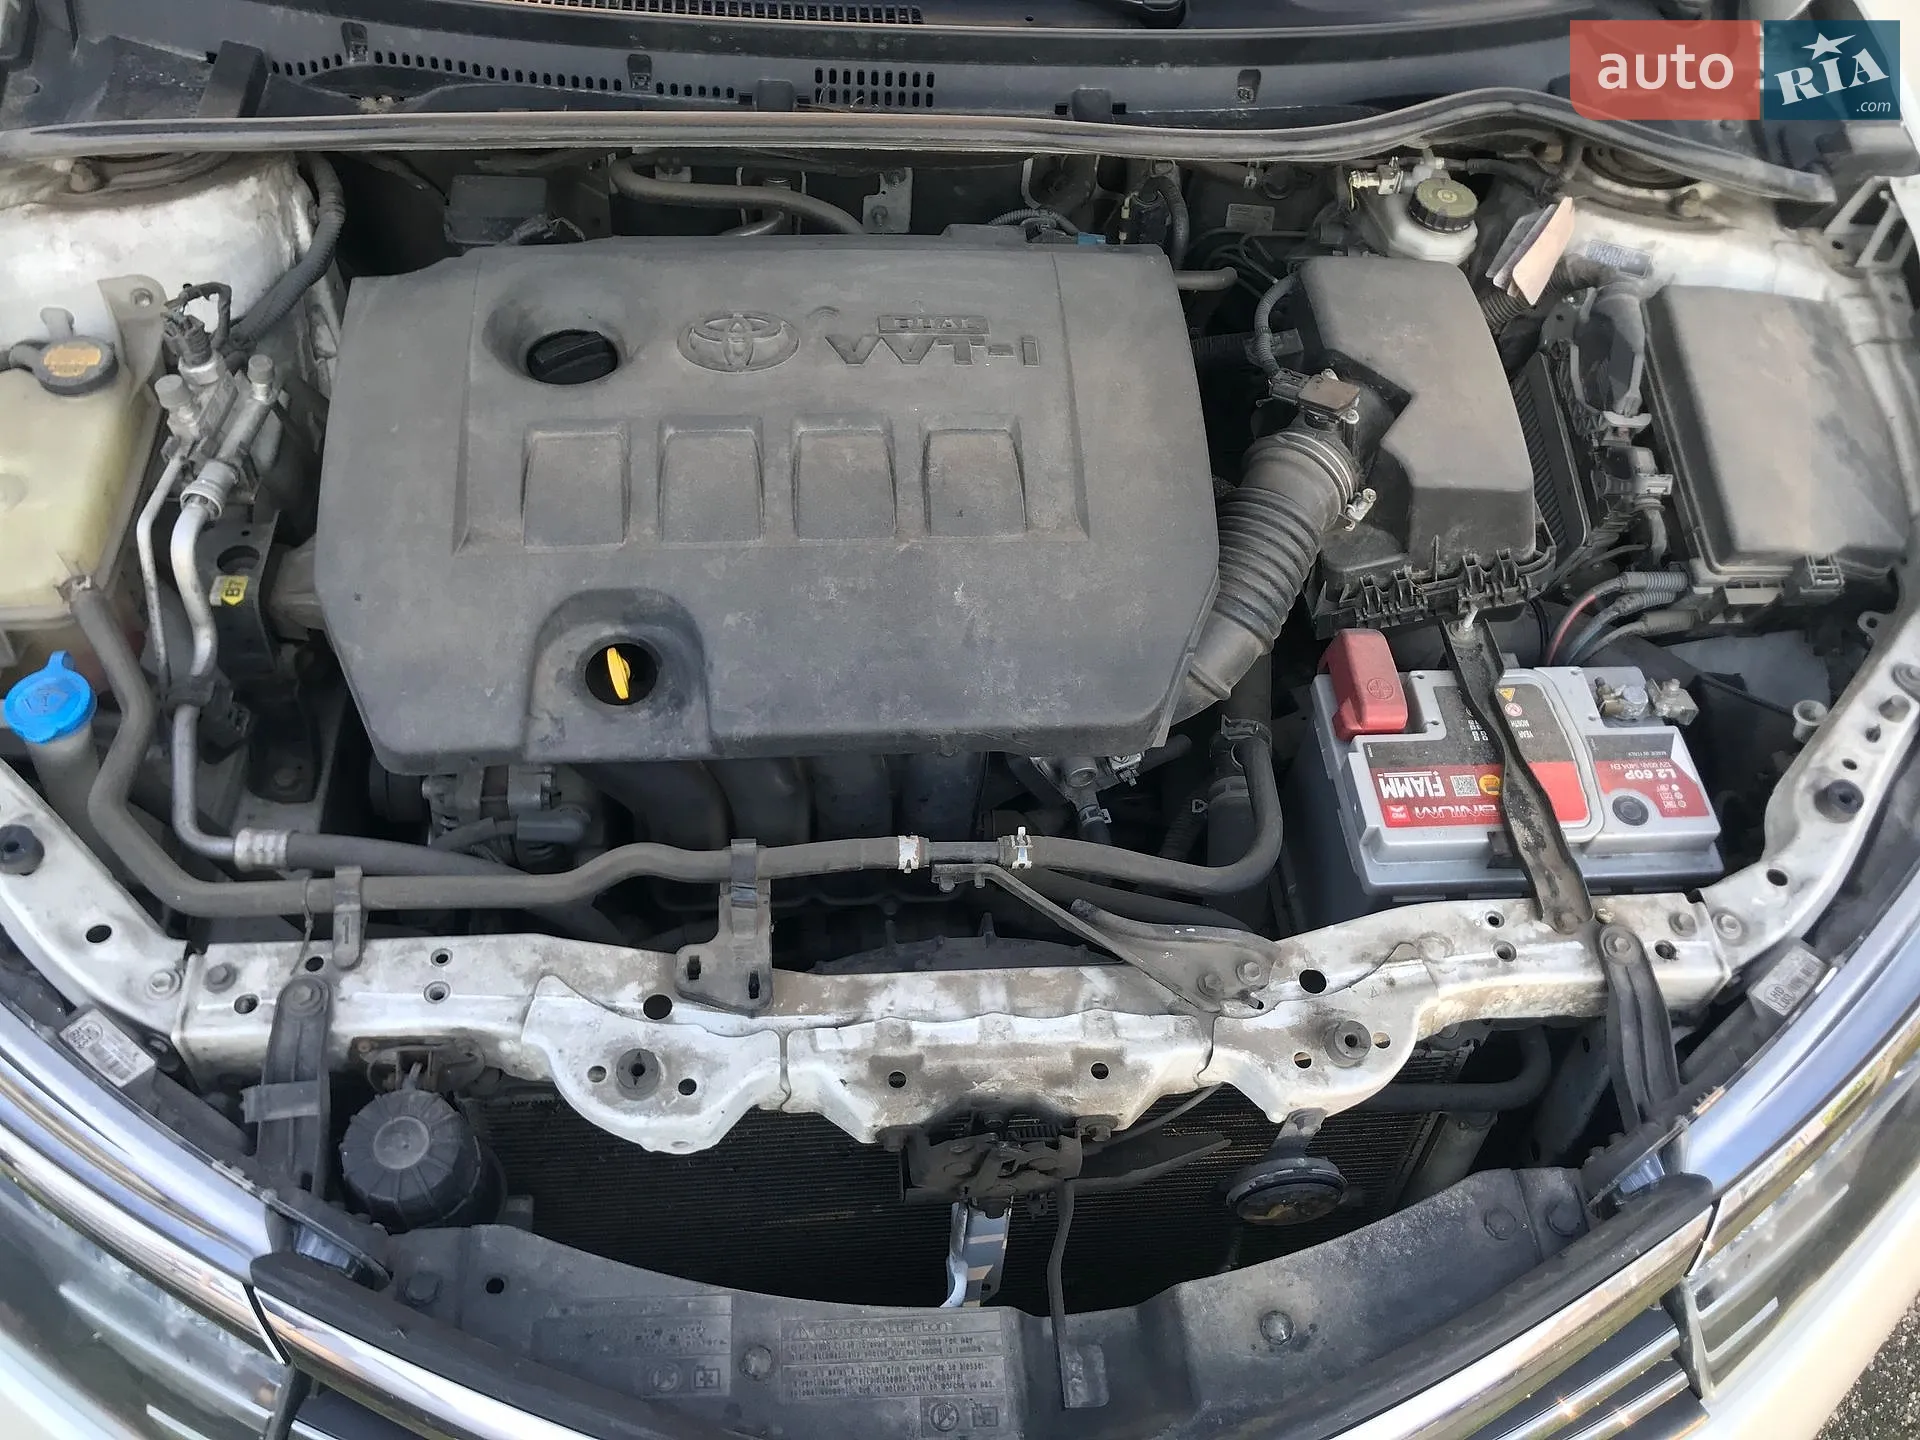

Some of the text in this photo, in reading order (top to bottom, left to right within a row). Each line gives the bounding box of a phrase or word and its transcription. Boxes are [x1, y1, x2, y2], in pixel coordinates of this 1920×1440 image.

[1517, 730, 1534, 738] YEAR
[1623, 768, 1677, 780] L2 60P
[1378, 775, 1446, 799] FIAMM
